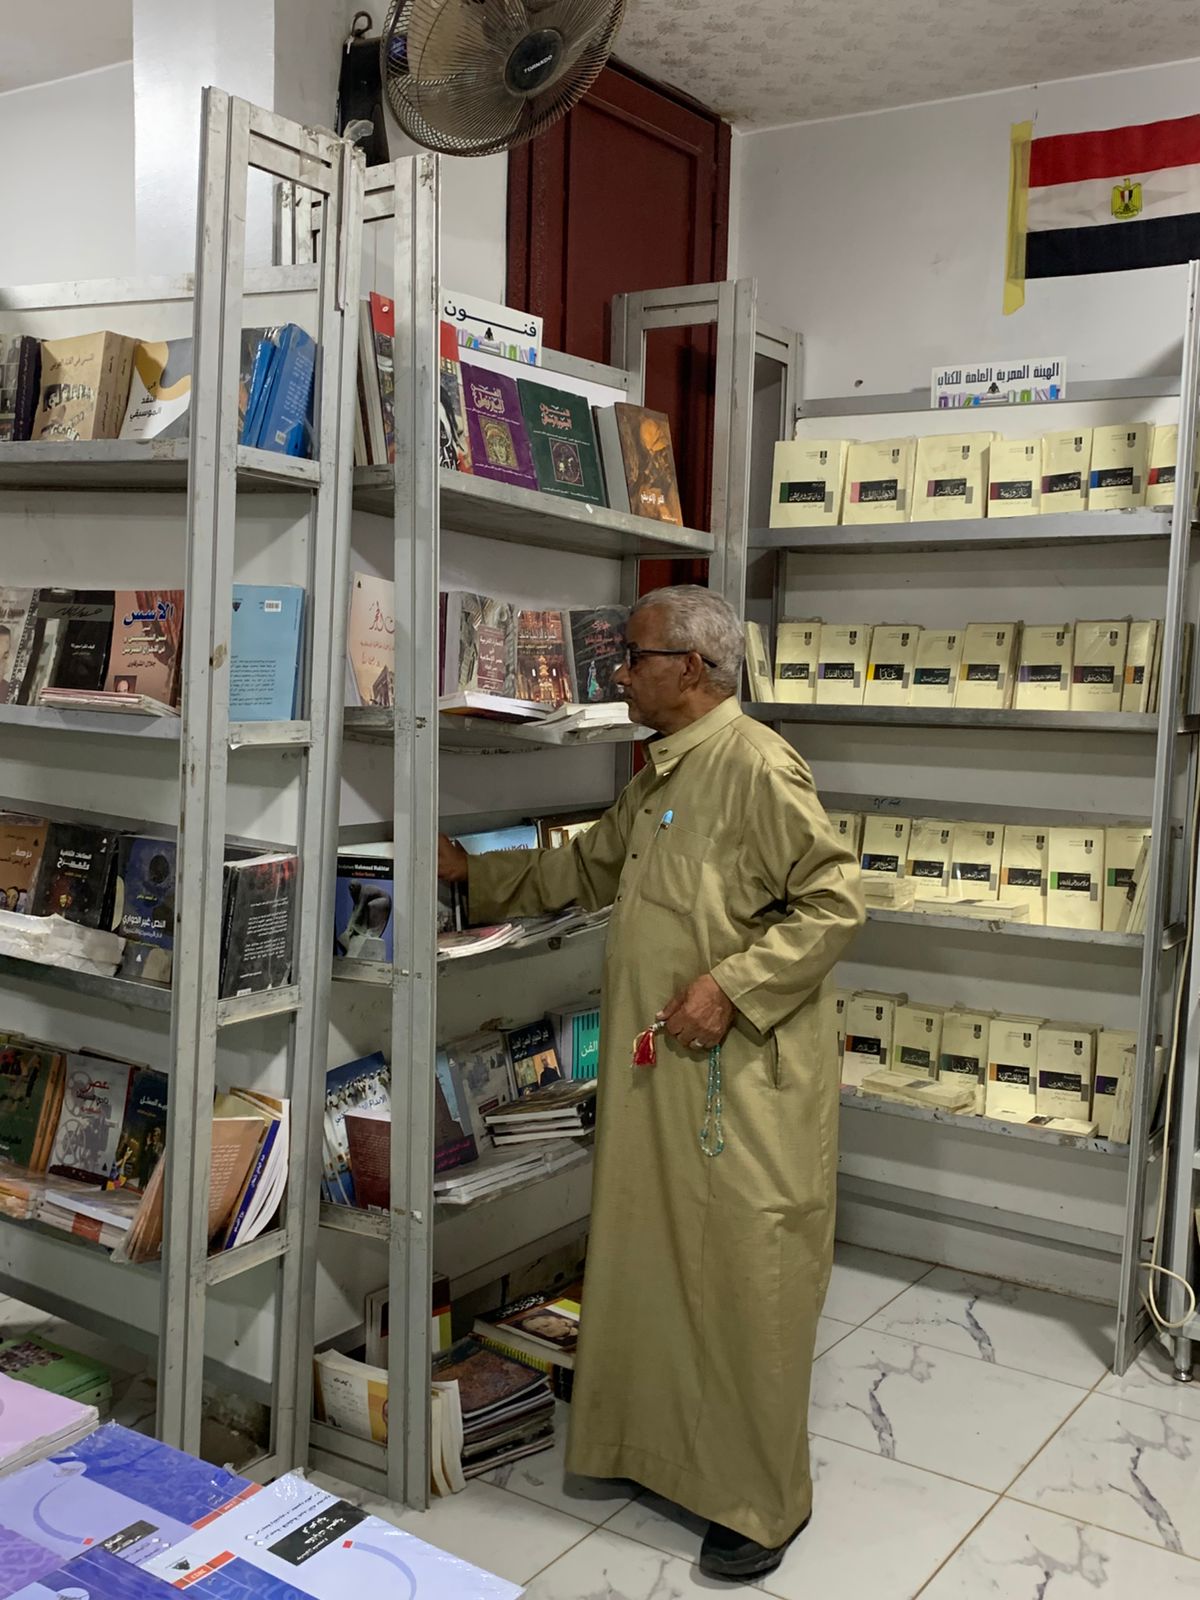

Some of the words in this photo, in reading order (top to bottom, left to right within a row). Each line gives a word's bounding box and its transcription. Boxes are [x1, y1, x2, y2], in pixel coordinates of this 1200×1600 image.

[523, 54, 553, 73] TORNADO
[937, 370, 962, 389] للكتاب
[965, 367, 993, 384] العامة
[996, 364, 1030, 383] المصرية
[1033, 361, 1060, 380] الهيئة
